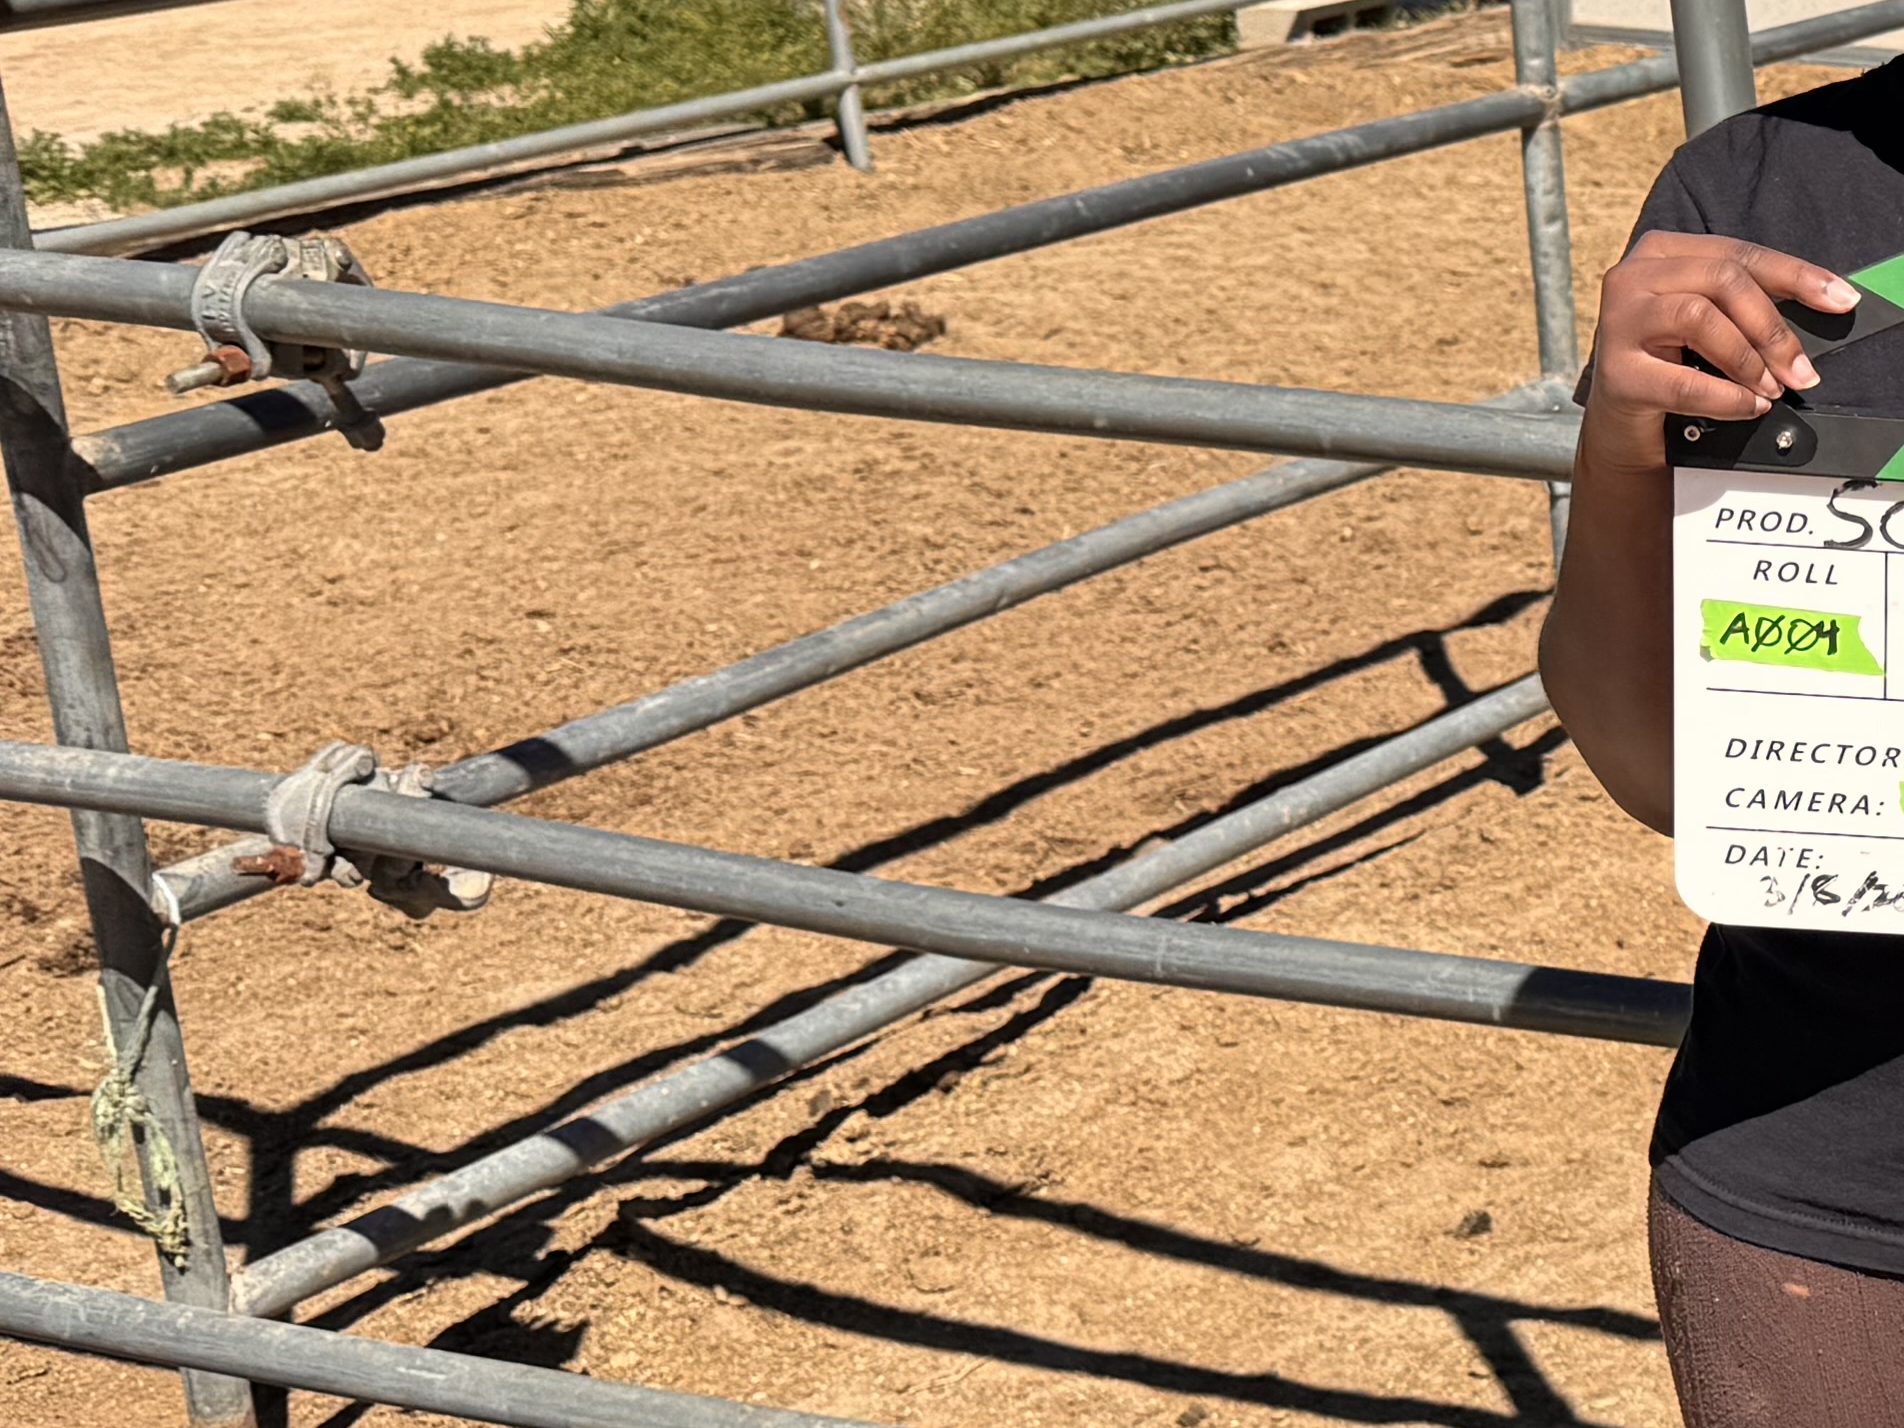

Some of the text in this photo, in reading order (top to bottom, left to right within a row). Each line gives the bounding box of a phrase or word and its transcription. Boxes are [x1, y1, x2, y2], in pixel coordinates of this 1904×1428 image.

[1715, 508, 1815, 535] PROD.
[1753, 560, 1838, 585] ROLL
[1725, 787, 1885, 816] CAMERA:
[1725, 844, 1824, 870] DATE:
